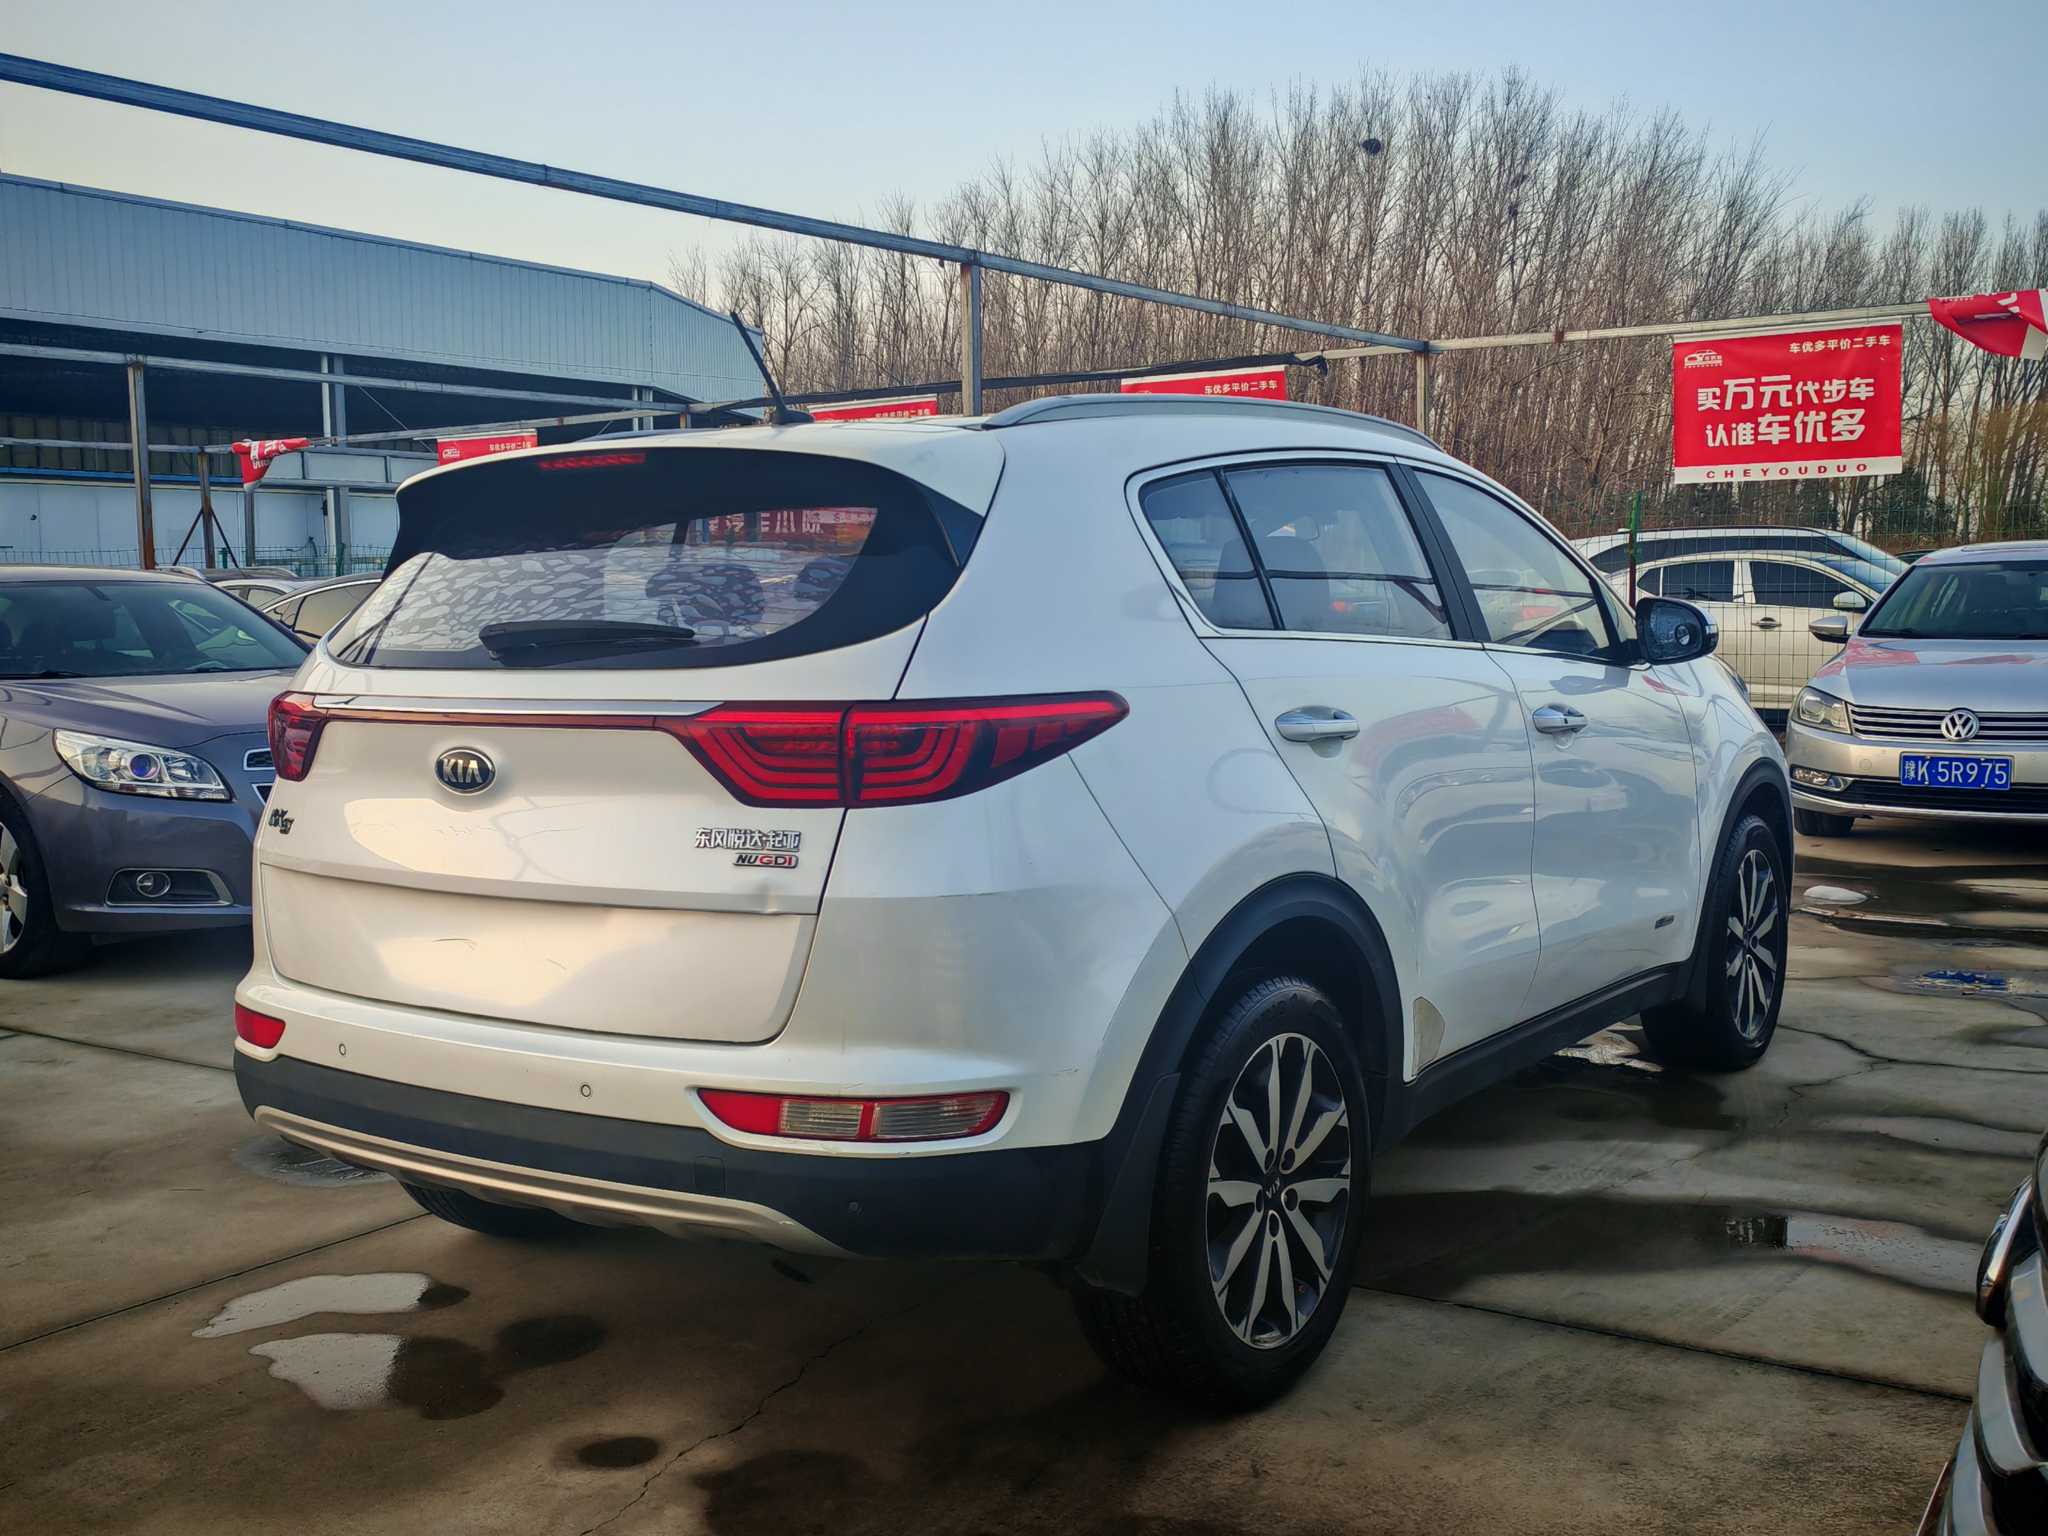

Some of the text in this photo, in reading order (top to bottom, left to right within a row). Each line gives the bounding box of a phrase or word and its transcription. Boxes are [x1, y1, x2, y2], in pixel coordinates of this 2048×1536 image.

[1789, 335, 1890, 353] 车优多平价二手车
[1697, 375, 1875, 411] 买万元代步车
[1705, 409, 1865, 447] 认准车优多
[1706, 463, 1867, 479] CHEYOUDUO
[443, 758, 482, 783] KIA
